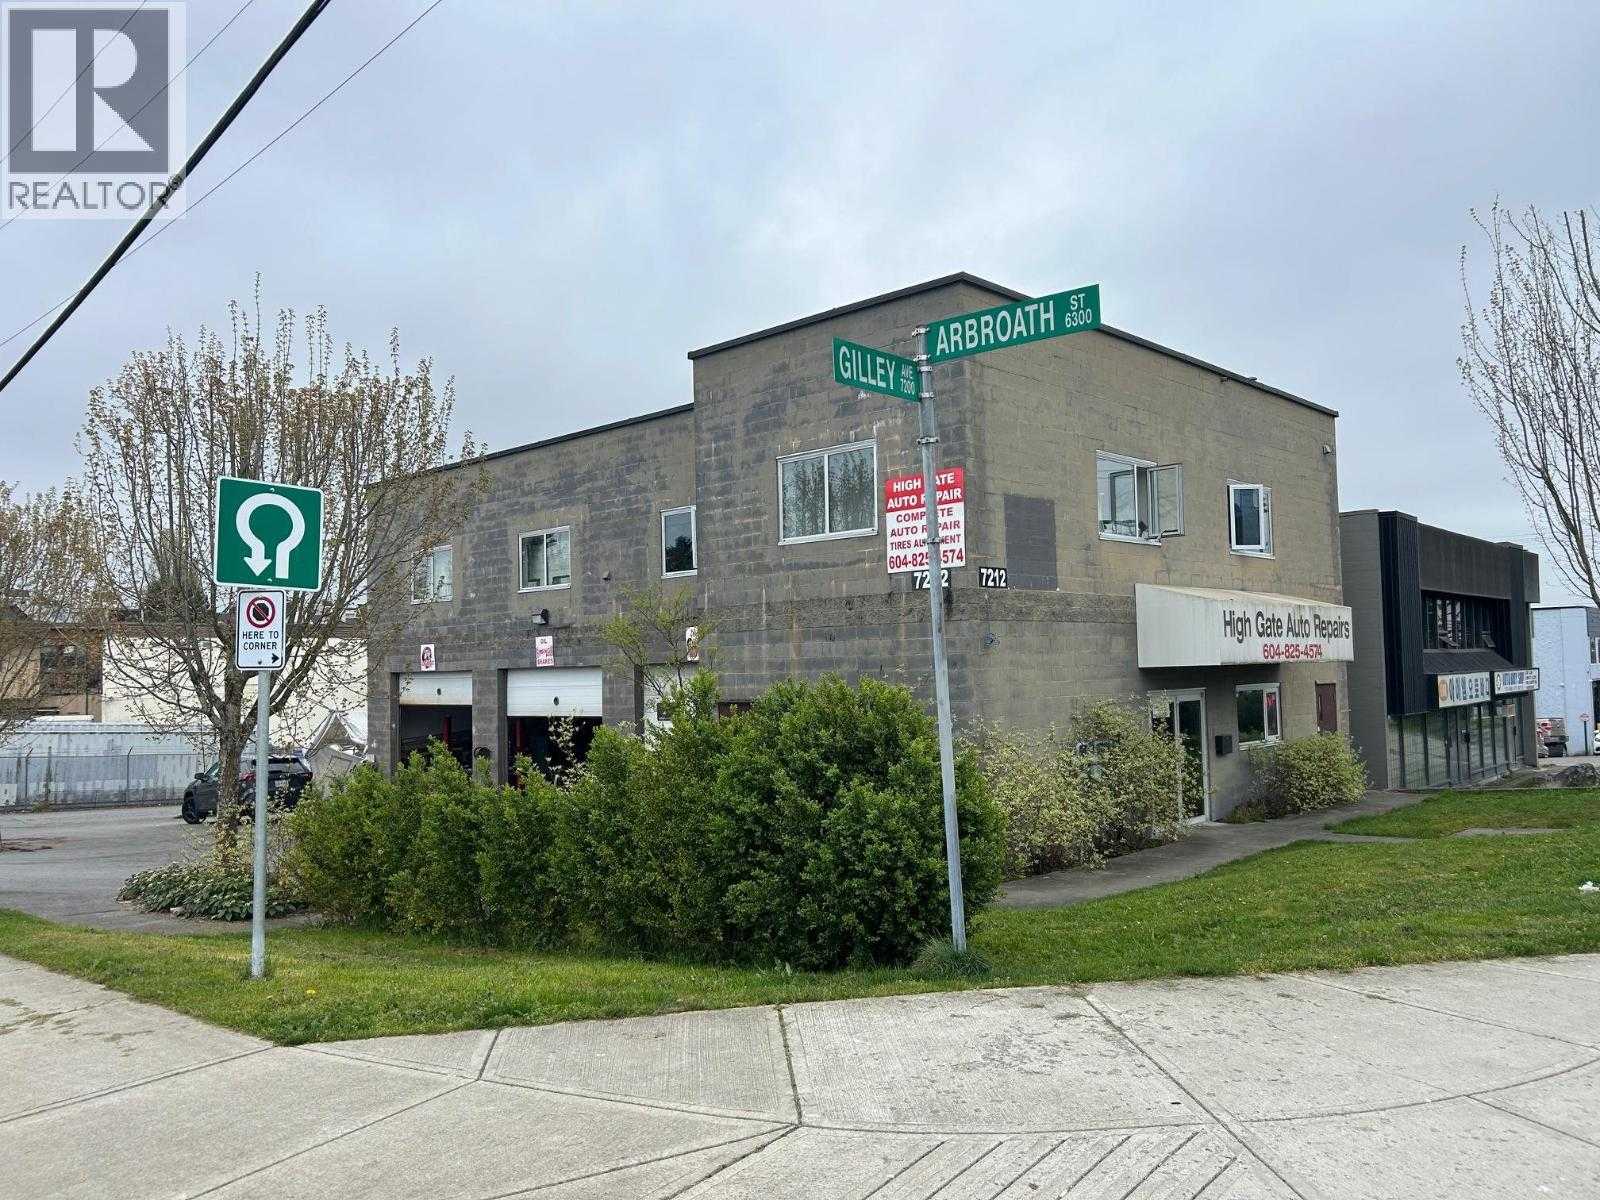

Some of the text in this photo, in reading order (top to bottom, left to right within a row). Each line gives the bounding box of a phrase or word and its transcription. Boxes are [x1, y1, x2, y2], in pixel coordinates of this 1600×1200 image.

[1070, 293, 1086, 311] ST
[1065, 308, 1093, 328] 6300
[936, 301, 1055, 356] ARBROATH
[840, 345, 896, 390] GILLEY
[901, 364, 913, 380] AVE
[900, 378, 915, 395] 7200
[893, 478, 922, 493] HIGH
[887, 487, 962, 510] AUTO RPAIR
[896, 506, 954, 523] COMPTE
[890, 526, 918, 538] AUTO
[890, 540, 912, 551] TIRES
[913, 569, 949, 589] 722
[980, 567, 1007, 587] 7212
[242, 630, 279, 640] HERE TO
[1223, 609, 1350, 644] High Gate Auto Repairs
[243, 641, 278, 650] CORNER
[1262, 643, 1322, 659] 604-825-4574
